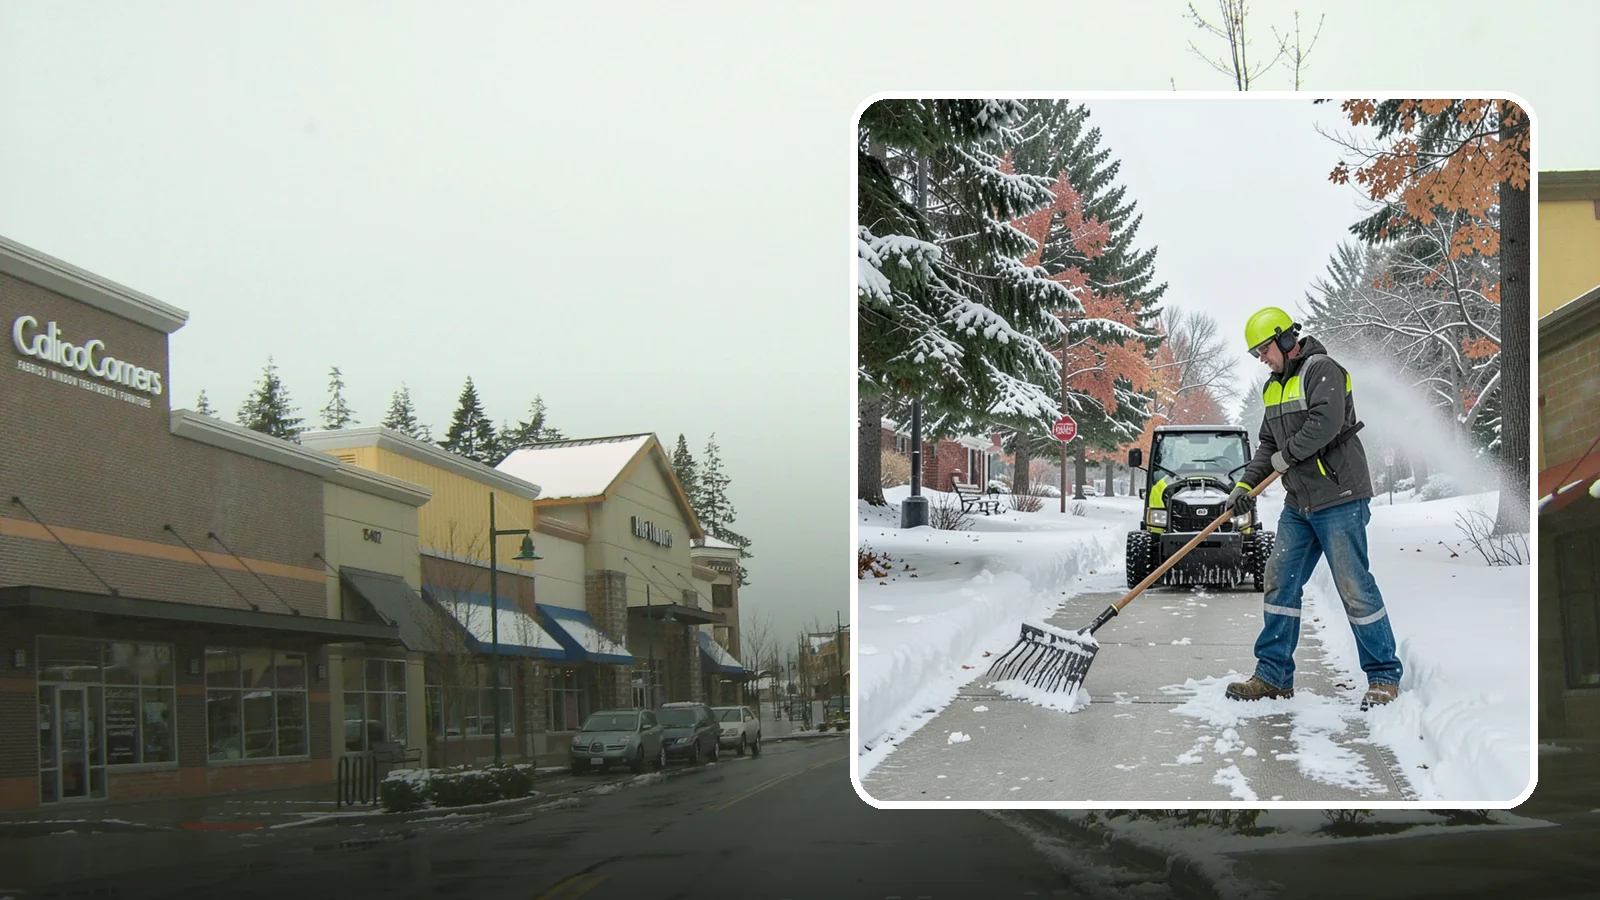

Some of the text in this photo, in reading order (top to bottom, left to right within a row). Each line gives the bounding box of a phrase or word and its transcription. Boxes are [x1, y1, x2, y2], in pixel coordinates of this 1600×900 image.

[17, 360, 151, 409] FABRICS WINDOW TREATMENTS FURNITURE
